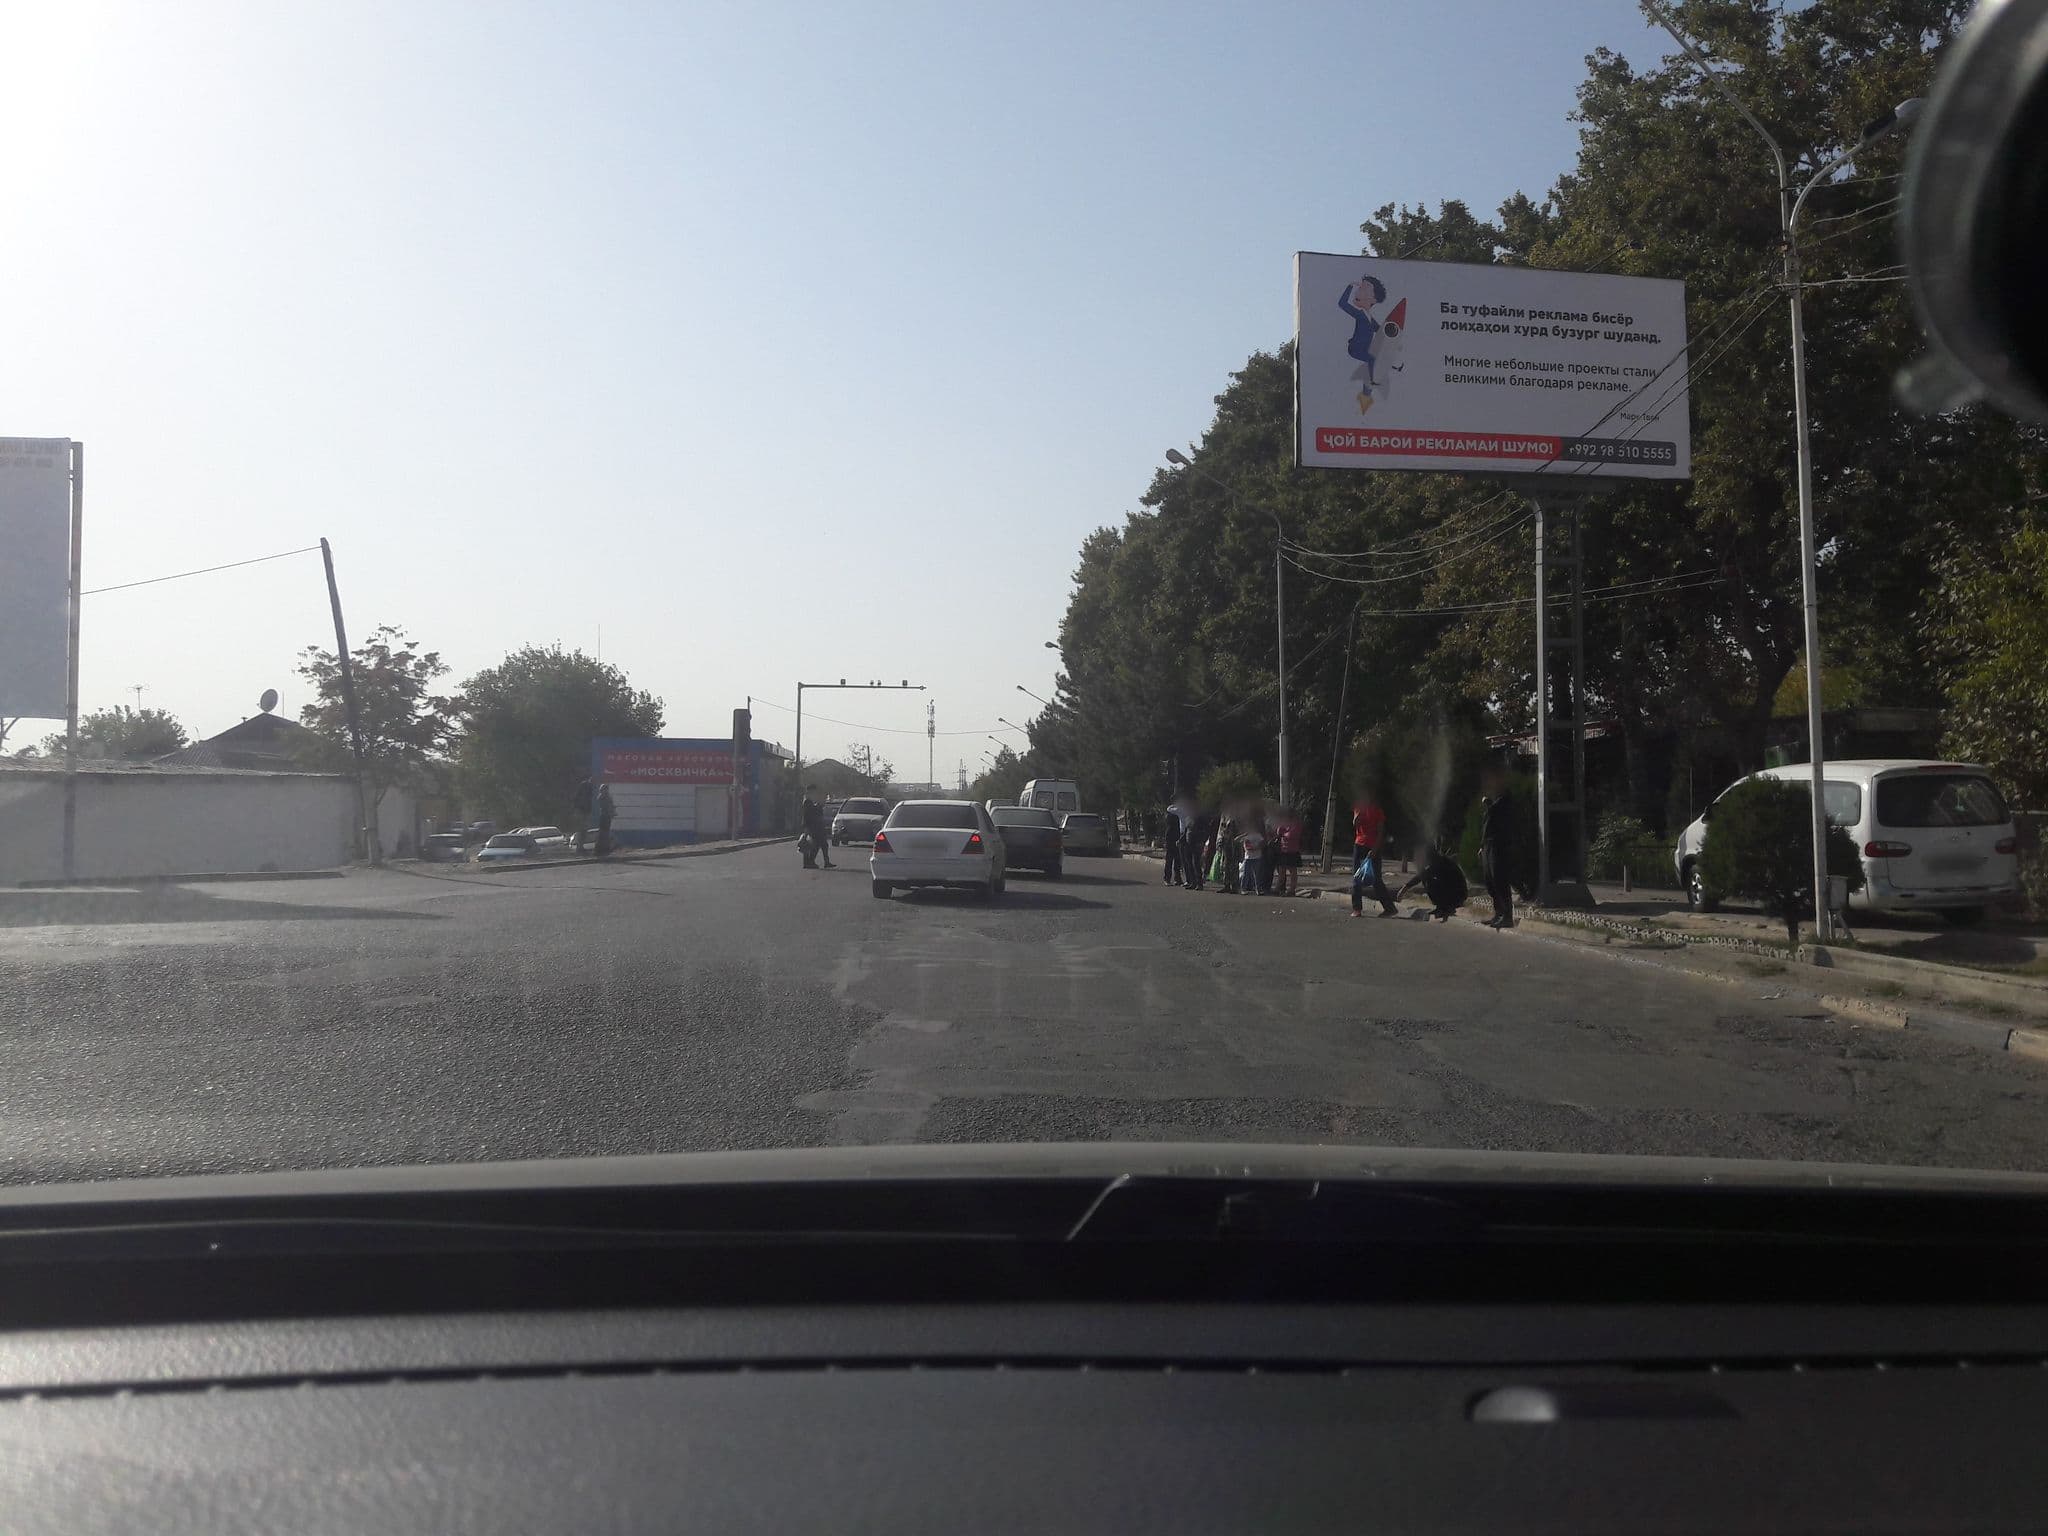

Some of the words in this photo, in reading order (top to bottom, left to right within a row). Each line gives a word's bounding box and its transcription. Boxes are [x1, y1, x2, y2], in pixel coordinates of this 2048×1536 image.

[1440, 301, 1458, 314] Ба
[1462, 304, 1525, 318] туфайли
[1528, 309, 1588, 322] реклама
[1592, 312, 1633, 327] бисёр
[1440, 320, 1510, 334] лоиҳаҳои
[1513, 325, 1548, 338] хурд
[1552, 325, 1600, 341] бузург
[1603, 331, 1662, 345] шуданд.
[1444, 355, 1491, 369] Многие
[1494, 358, 1564, 373] небольшие
[1567, 363, 1619, 376] проекты
[1622, 367, 1656, 378] стали
[1444, 373, 1506, 386] великими
[1509, 374, 1574, 390] благодаря
[1577, 380, 1632, 393] рекламе.
[1359, 435, 1413, 449] БАРОИ
[1416, 437, 1498, 452] РЕКЛАМАИ
[1501, 440, 1553, 455] ШУМО!
[1618, 446, 1639, 458] 510
[1642, 447, 1673, 460] 5555
